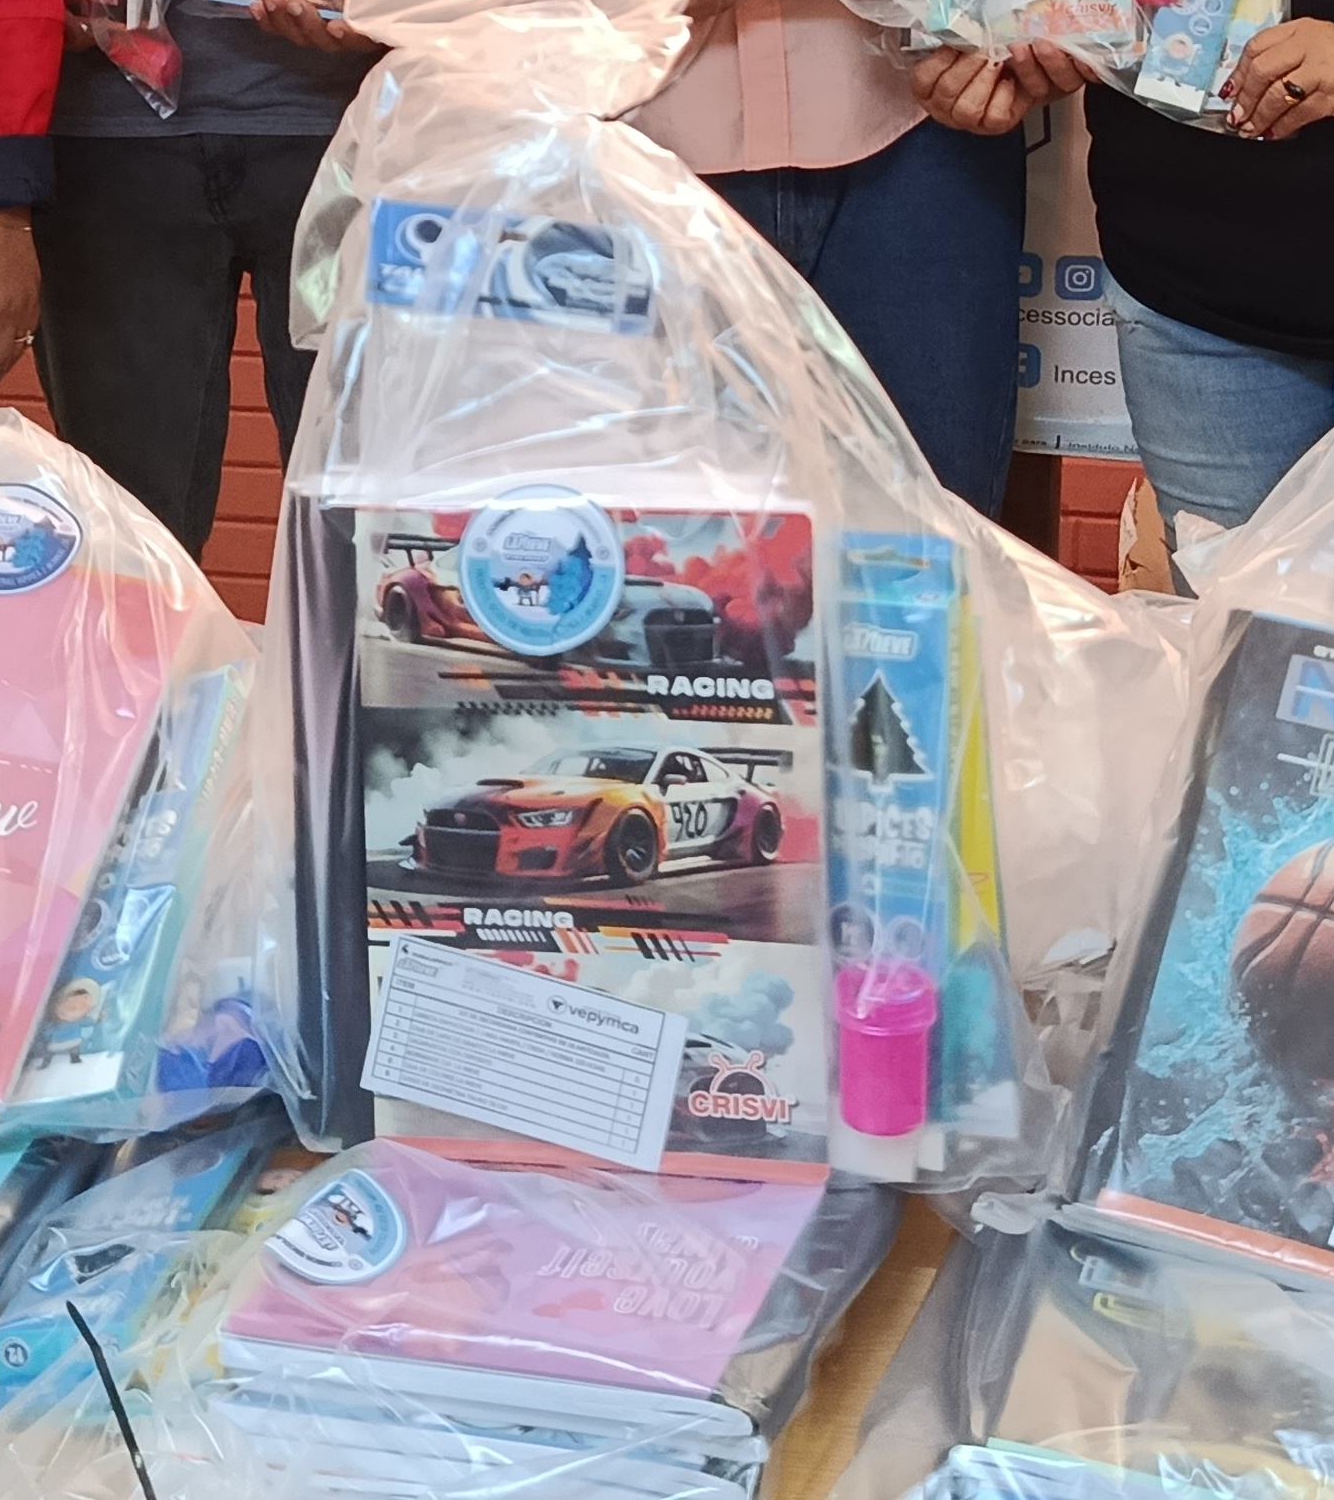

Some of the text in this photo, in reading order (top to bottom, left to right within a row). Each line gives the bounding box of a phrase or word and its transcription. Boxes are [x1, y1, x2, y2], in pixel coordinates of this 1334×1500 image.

[1054, 365, 1117, 385] Inces
[647, 675, 775, 699] RACING
[463, 908, 574, 930] RACING
[569, 1003, 640, 1035] vepymca
[691, 1091, 790, 1122] CRISVI
